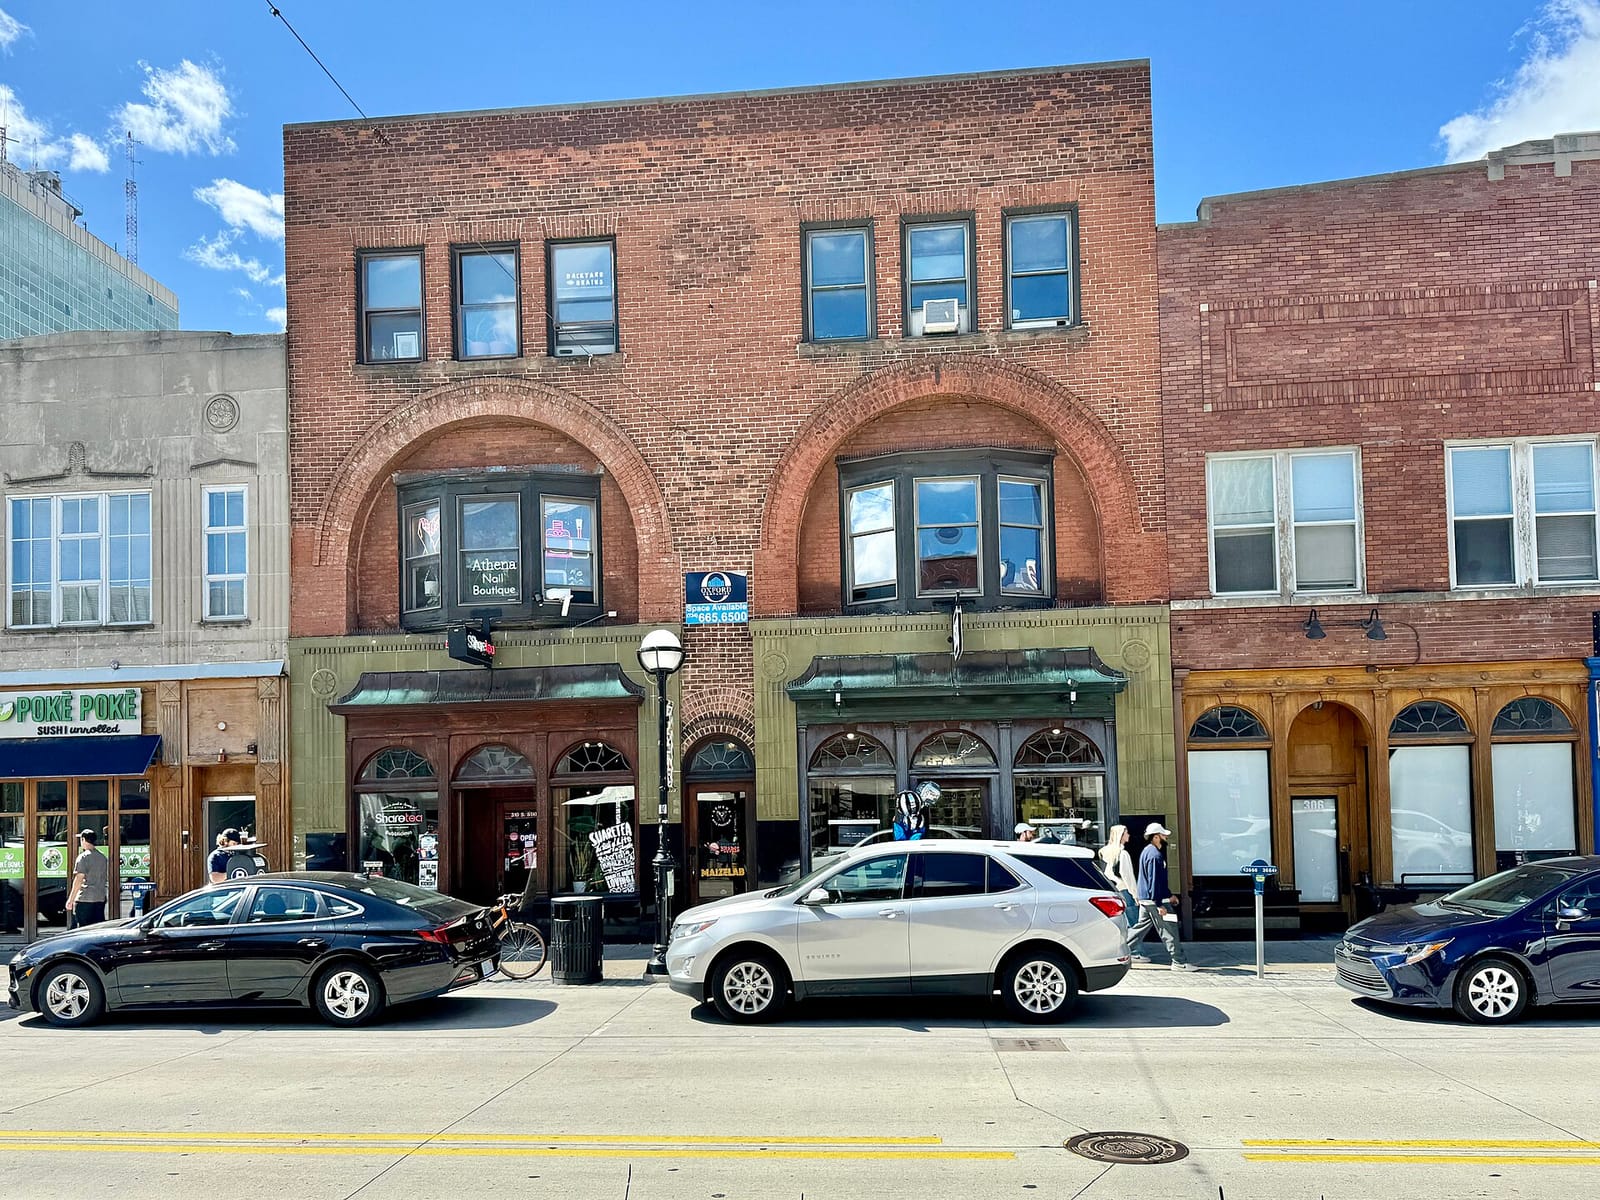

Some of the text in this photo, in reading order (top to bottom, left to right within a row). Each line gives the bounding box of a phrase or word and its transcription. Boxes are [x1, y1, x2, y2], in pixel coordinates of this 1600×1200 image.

[566, 271, 604, 279] BACKYARD
[472, 558, 517, 571] Athena
[482, 573, 504, 583] Nail
[473, 585, 516, 596] Boutique
[701, 587, 732, 595] OXFORD
[686, 604, 711, 613] Space
[698, 611, 747, 623] 665.6500
[37, 724, 120, 735] SUSHI unrolled
[1303, 800, 1325, 809] 306
[375, 813, 423, 823] Sharetea
[701, 867, 745, 877] MAIZELAB
